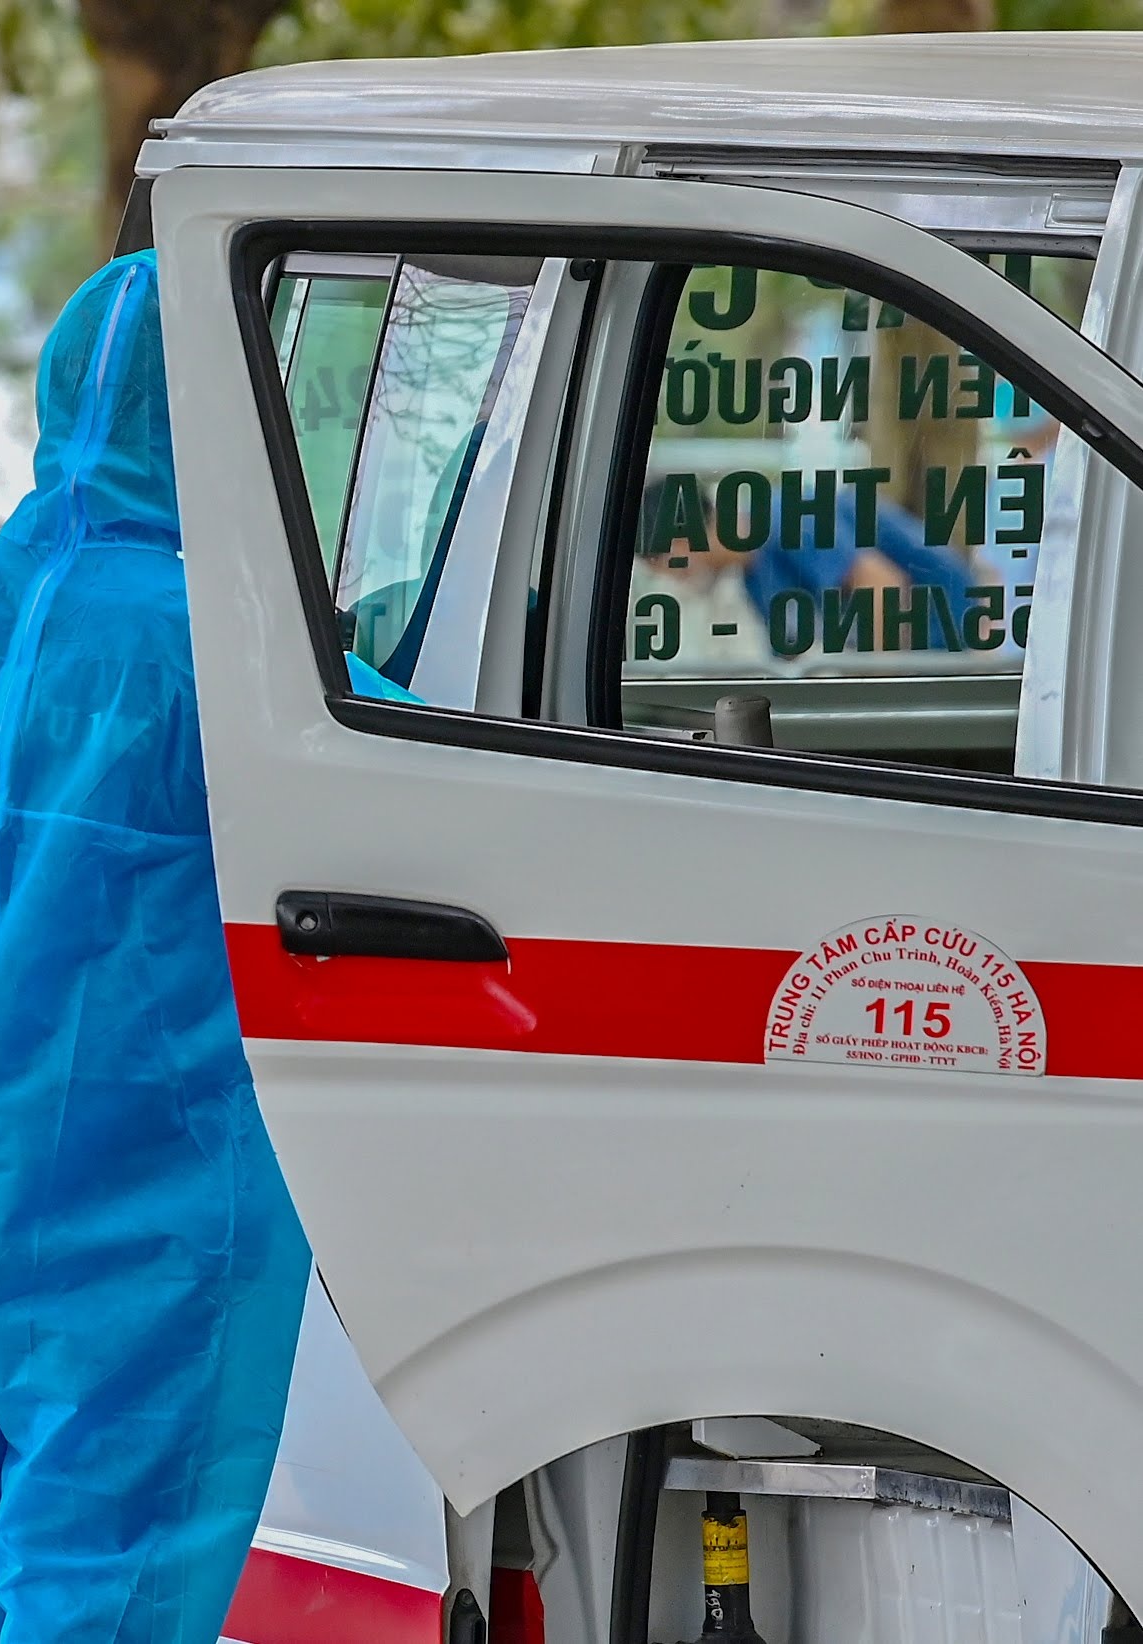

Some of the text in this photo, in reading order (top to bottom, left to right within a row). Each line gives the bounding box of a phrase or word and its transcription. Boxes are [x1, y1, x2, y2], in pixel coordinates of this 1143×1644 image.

[861, 950, 892, 965] Chu
[823, 961, 858, 986] Phan
[945, 956, 980, 985] Hoàn
[769, 918, 1041, 1071] TRUNG TÂM CẤP CỨU 115 HÀ NỘI
[811, 985, 827, 1001] 11
[851, 976, 965, 996] SỐ ĐIỆN THOẠI LIÊN HỆ
[865, 998, 951, 1038] 115
[816, 1033, 830, 1044] SỐ
[832, 1034, 858, 1047] GIẤY
[862, 1037, 889, 1048] PHÉP
[891, 1039, 921, 1051] HOẠT
[923, 1041, 954, 1053] ĐỘNG
[998, 1025, 1011, 1045] Hà
[928, 1056, 957, 1066] TTYT
[997, 1047, 1012, 1070] Nội
